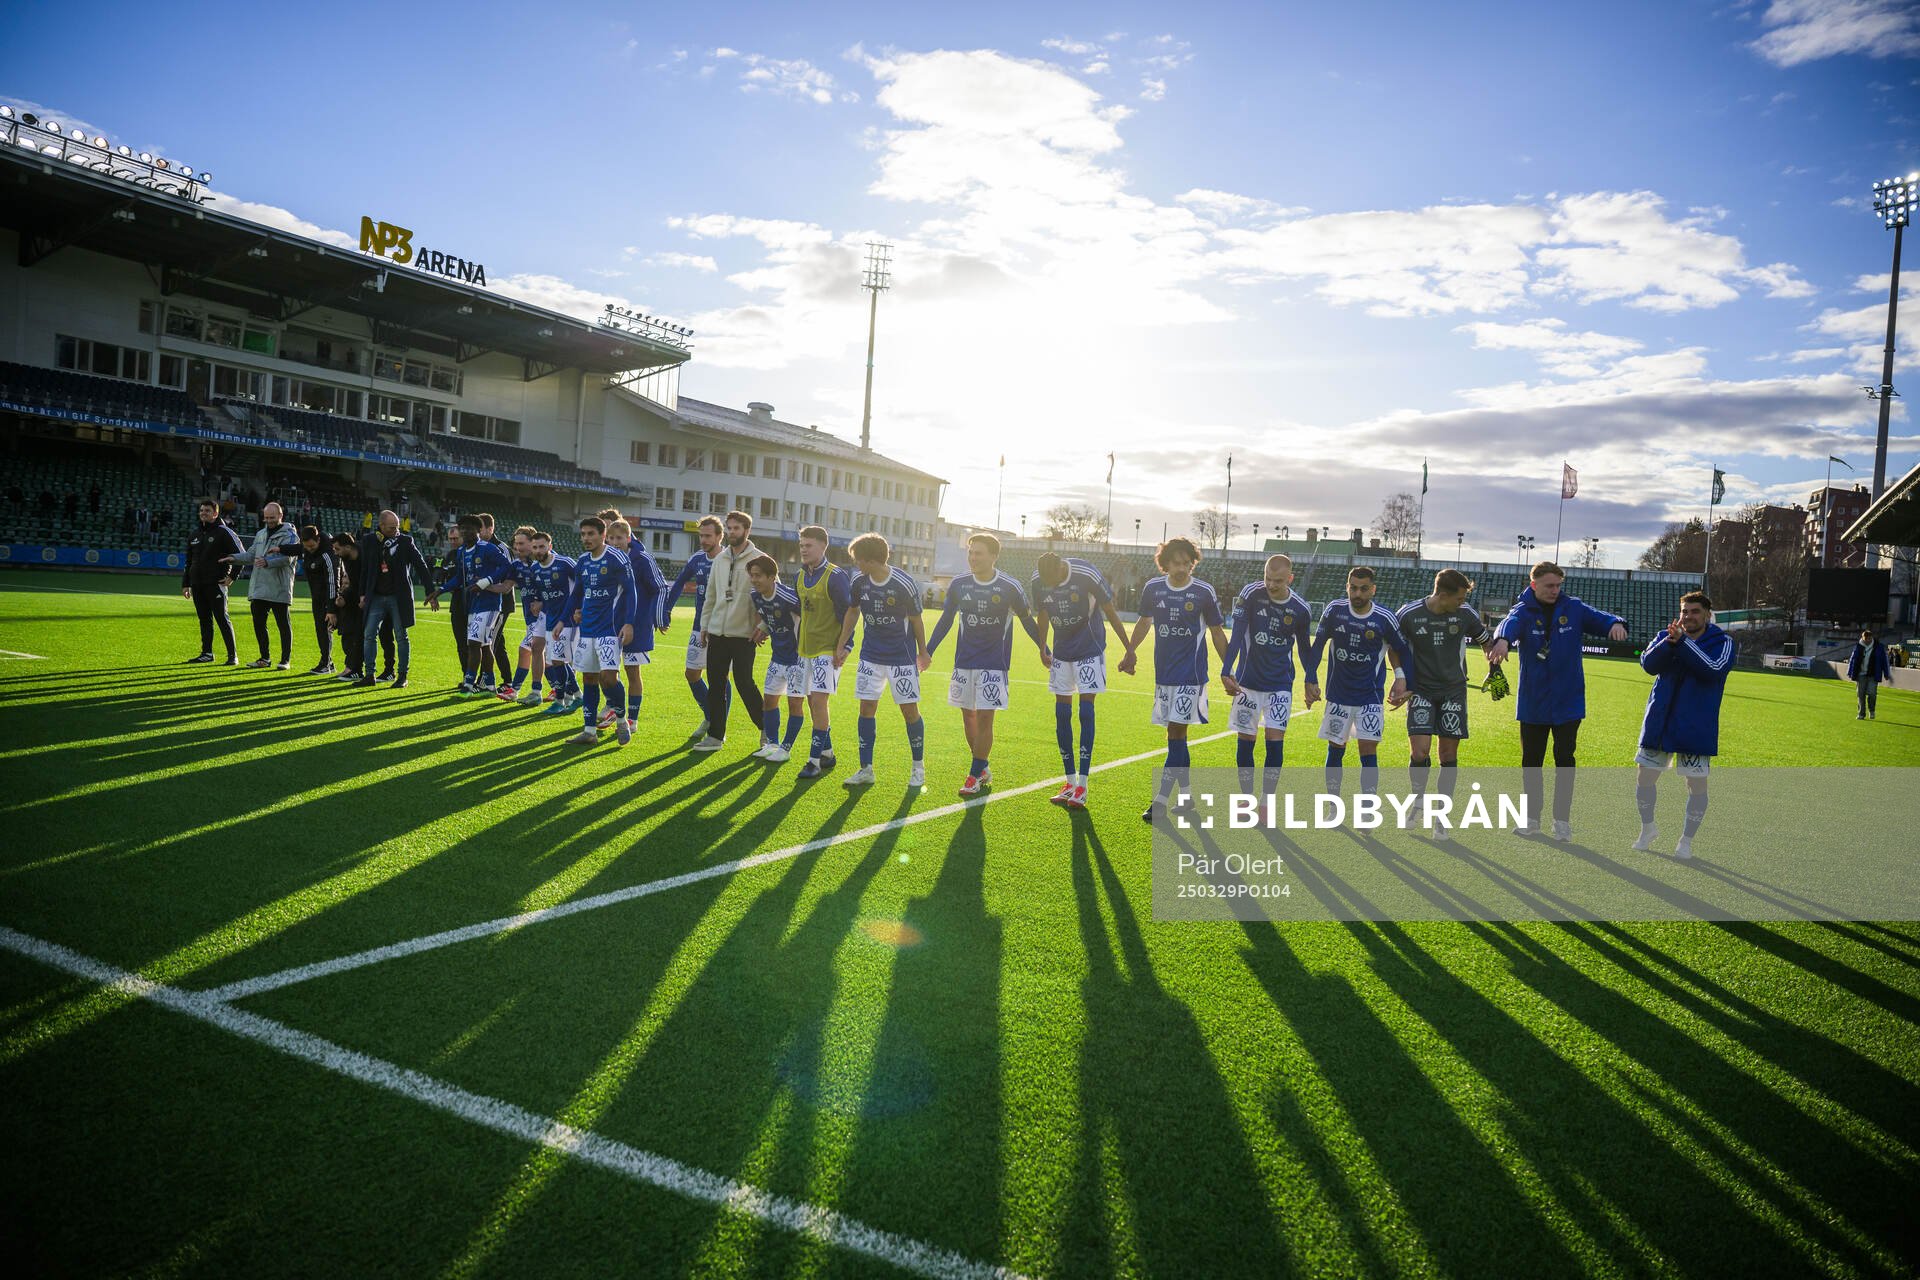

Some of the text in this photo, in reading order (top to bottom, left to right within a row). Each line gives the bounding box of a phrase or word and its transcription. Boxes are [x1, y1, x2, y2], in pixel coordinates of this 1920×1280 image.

[360, 216, 486, 287] NP3 ARENA
[72, 412, 89, 421] GIF
[95, 415, 148, 429] Sundsvall
[198, 429, 257, 445] Tillsammans
[285, 441, 298, 449] GIF
[301, 444, 342, 456] Sundsvall
[592, 589, 609, 599] SCA
[876, 616, 897, 625] SCA
[980, 616, 1001, 625] SCA
[1171, 627, 1192, 637] SCA
[1269, 637, 1288, 647] SCA
[1349, 652, 1371, 662] SCA
[1581, 645, 1609, 655] UNIBET
[891, 665, 913, 679] Diös
[981, 670, 1001, 685] Diös
[1238, 692, 1258, 710] Diös
[1268, 692, 1289, 706] Diös
[1330, 703, 1350, 720] Diös
